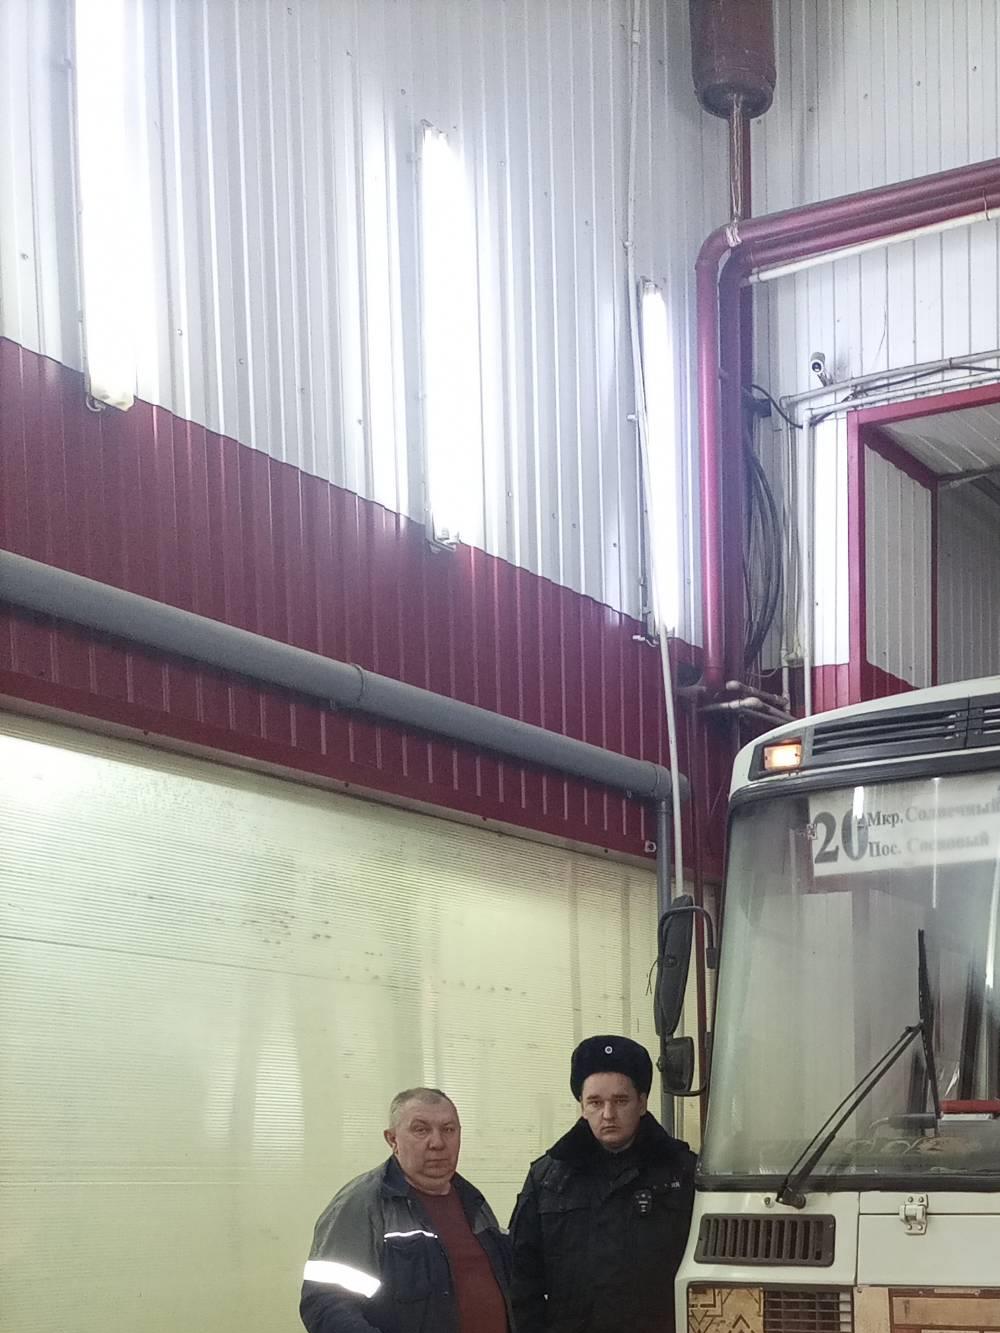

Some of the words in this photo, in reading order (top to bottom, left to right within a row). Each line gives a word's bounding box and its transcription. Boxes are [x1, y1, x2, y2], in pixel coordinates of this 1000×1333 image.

[868, 810, 904, 829] Мкр.
[814, 809, 869, 864] 20
[868, 841, 902, 858] Пос.
